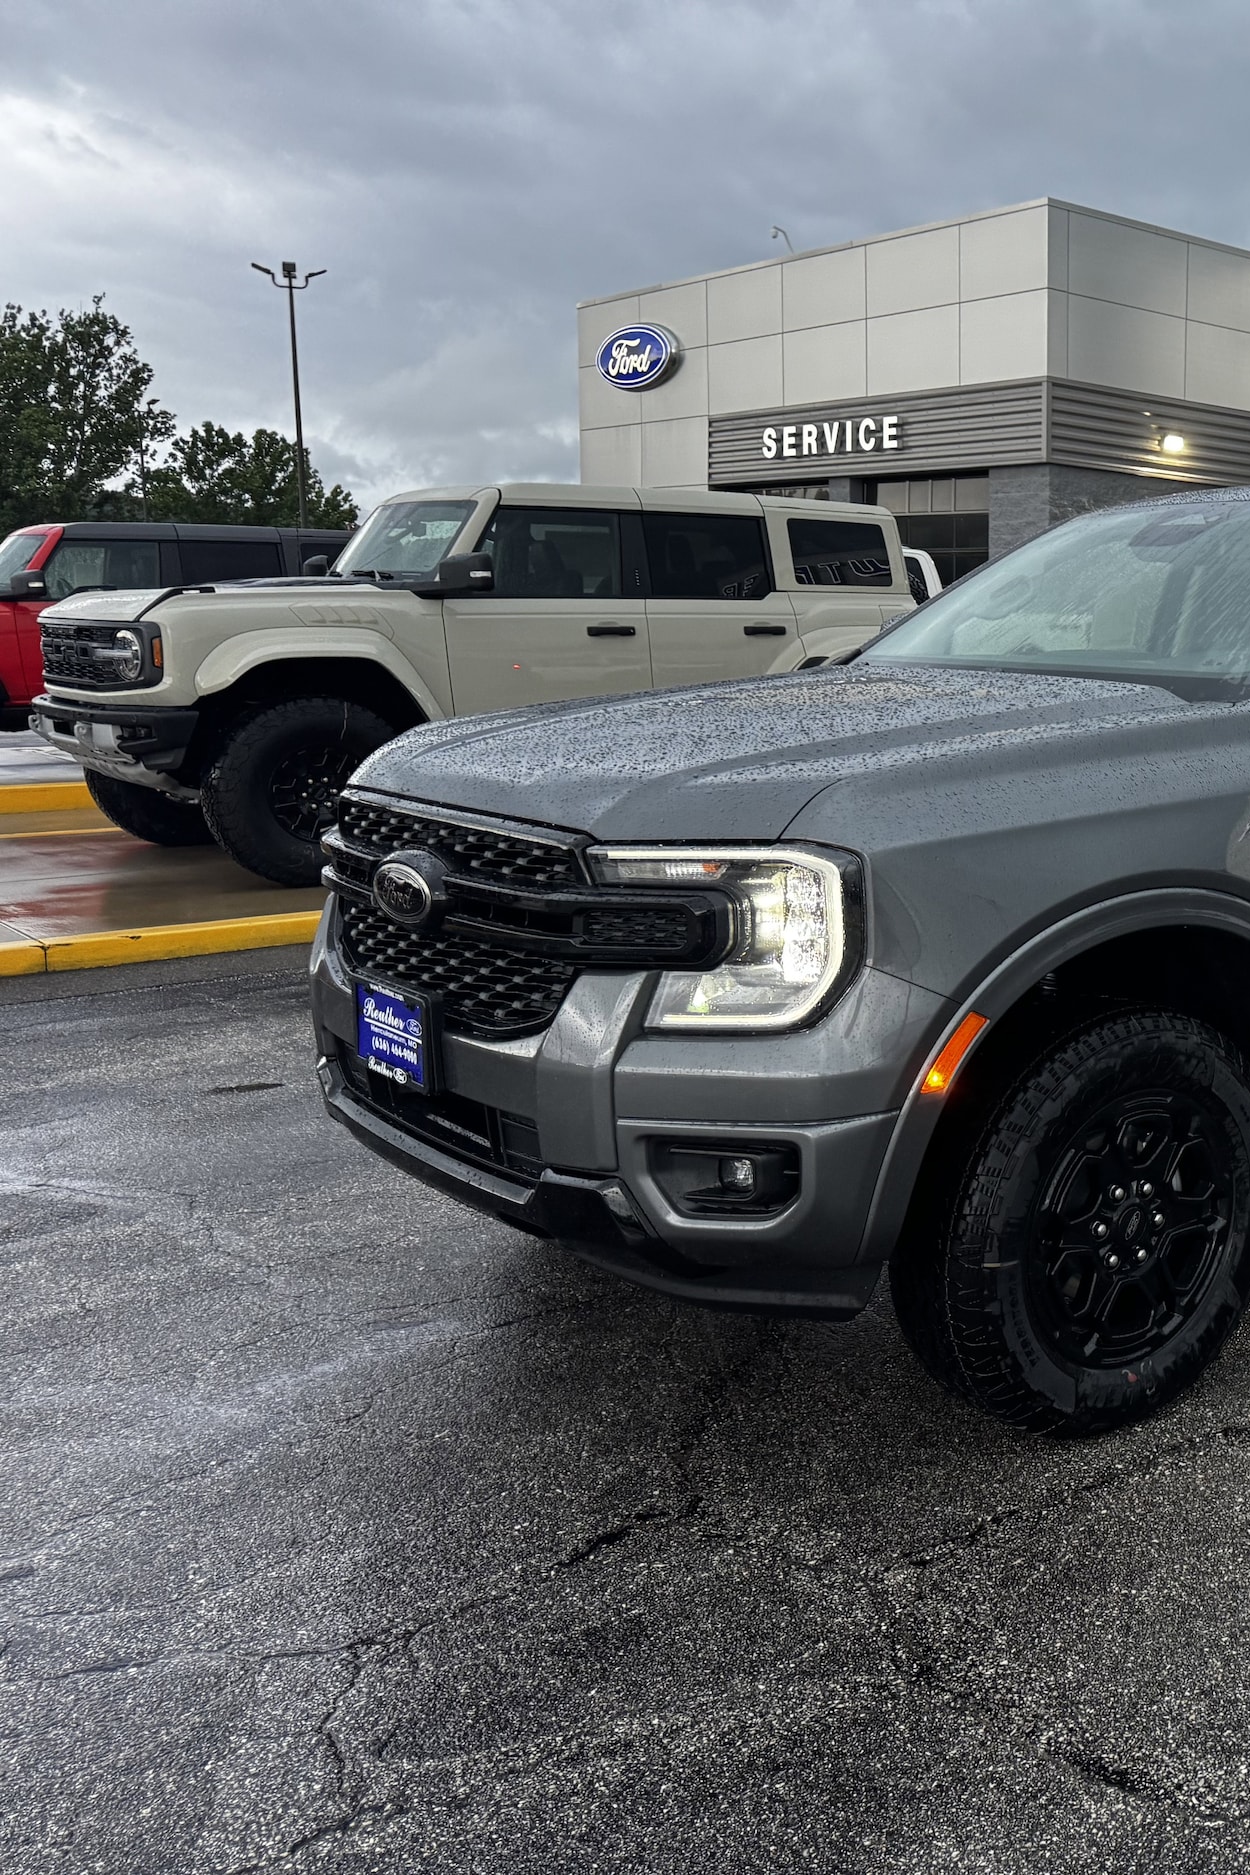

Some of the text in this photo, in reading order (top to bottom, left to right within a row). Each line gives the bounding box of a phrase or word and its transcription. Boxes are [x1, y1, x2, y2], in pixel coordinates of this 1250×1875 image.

[608, 338, 652, 377] Ford
[762, 415, 898, 459] SERVICE
[383, 870, 414, 910] Ford
[363, 997, 405, 1031] Reuther
[407, 1039, 418, 1049] MO
[368, 1055, 394, 1079] Reuther
